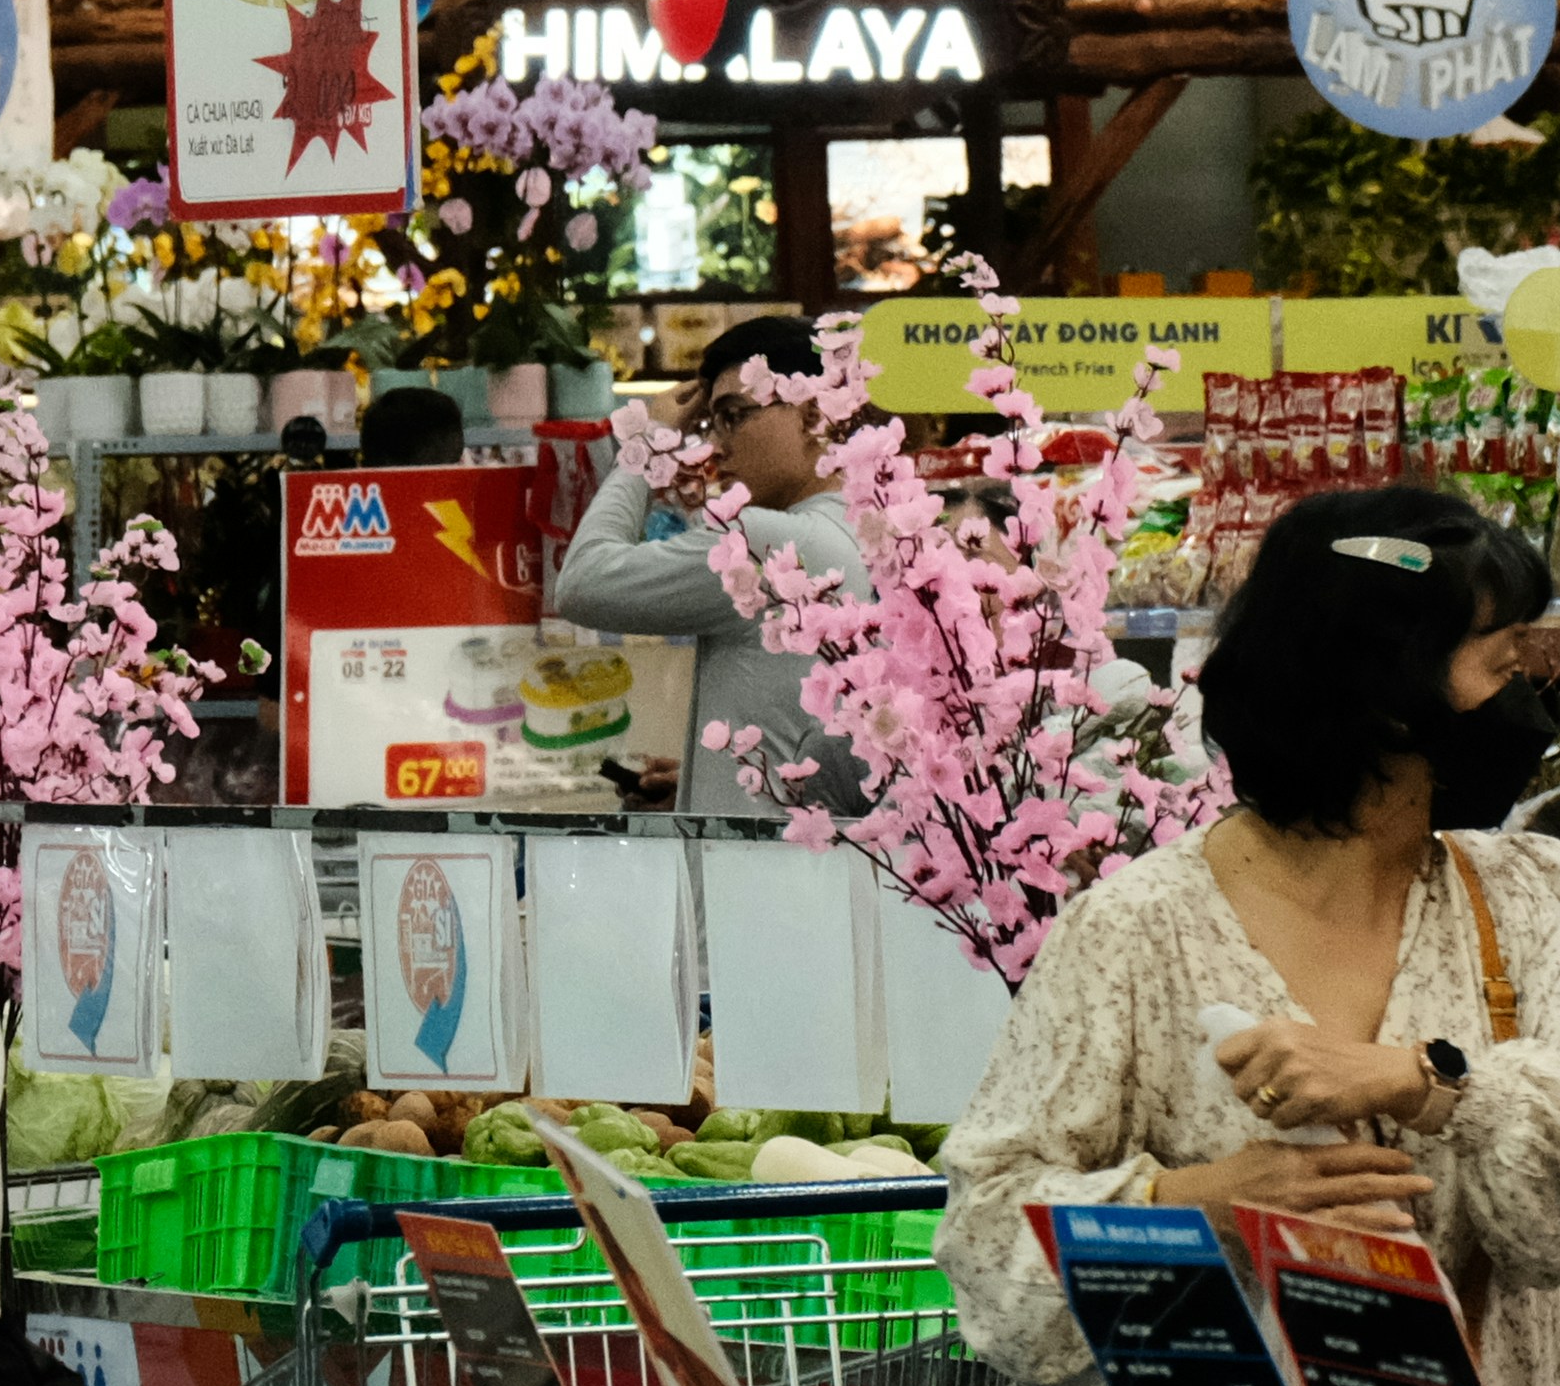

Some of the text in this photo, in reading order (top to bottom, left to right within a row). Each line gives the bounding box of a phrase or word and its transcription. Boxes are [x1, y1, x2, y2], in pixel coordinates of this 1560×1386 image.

[500, 9, 983, 83] HIMLAYA
[1057, 317, 1139, 344] ĐÔNG
[1074, 360, 1116, 377] Fries
[342, 661, 406, 679] 08 22
[397, 758, 441, 796] 67
